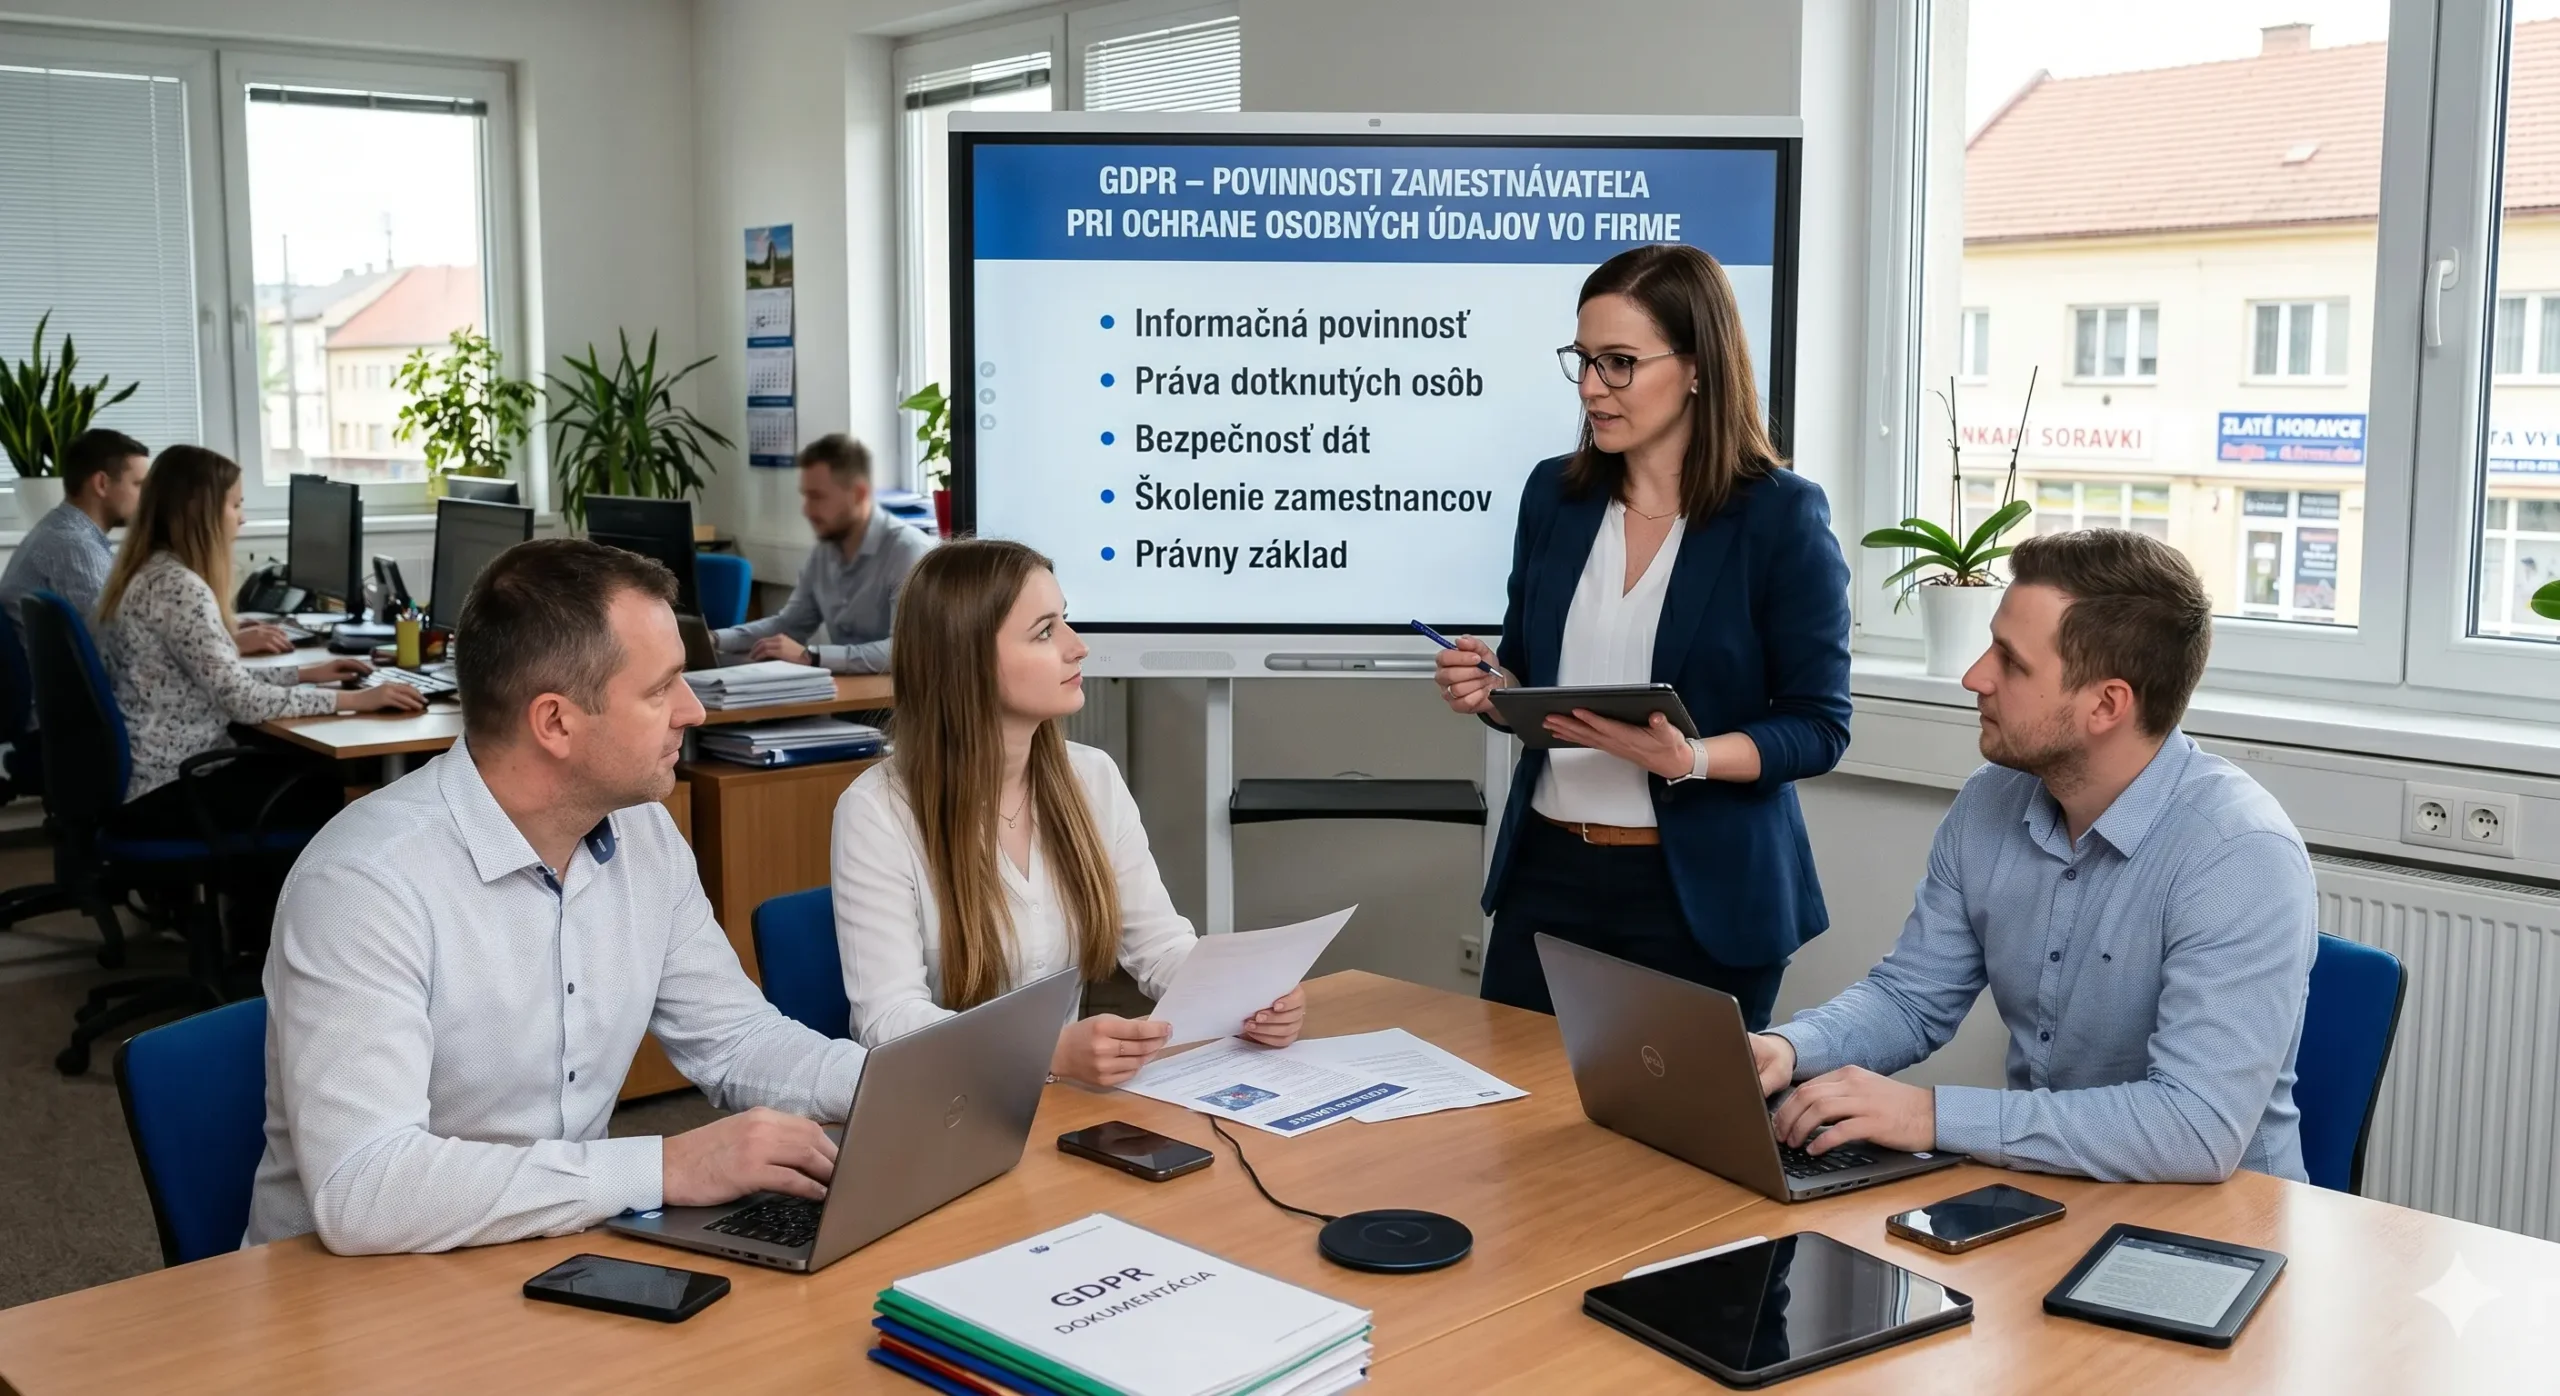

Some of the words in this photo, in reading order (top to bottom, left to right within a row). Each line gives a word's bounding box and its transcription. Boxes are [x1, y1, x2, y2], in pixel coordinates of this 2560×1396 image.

[1099, 166, 1177, 195] GDPR
[1213, 166, 1382, 197] POVINNOSTI
[1390, 163, 1650, 198] ZAMESTNÁVATEĽA
[1067, 208, 1113, 237] PRI
[1122, 209, 1257, 238] OCHRANE
[1265, 204, 1419, 240] OSOBNÝCH
[1428, 204, 1541, 241] ÚDAJOV
[1547, 212, 1585, 241] VO
[1594, 212, 1681, 242] FIRME
[1136, 307, 1308, 338] Informačná
[1319, 309, 1471, 345] povinnosť
[1136, 365, 1220, 396] Práva
[1231, 366, 1401, 403] dotknutých
[1412, 366, 1483, 397] osôb
[1136, 422, 1314, 460] Bezpečnosť
[1322, 424, 1371, 454] dát
[2222, 414, 2273, 436] ZLATÉ
[1135, 474, 1264, 511] Školenie
[1274, 484, 1493, 512] zamestnancov
[1136, 538, 1239, 575] Právny
[1248, 538, 1347, 569] základ
[1050, 1266, 1155, 1308] GDPR
[1053, 1269, 1217, 1335] DOKUMENTÁCIA
